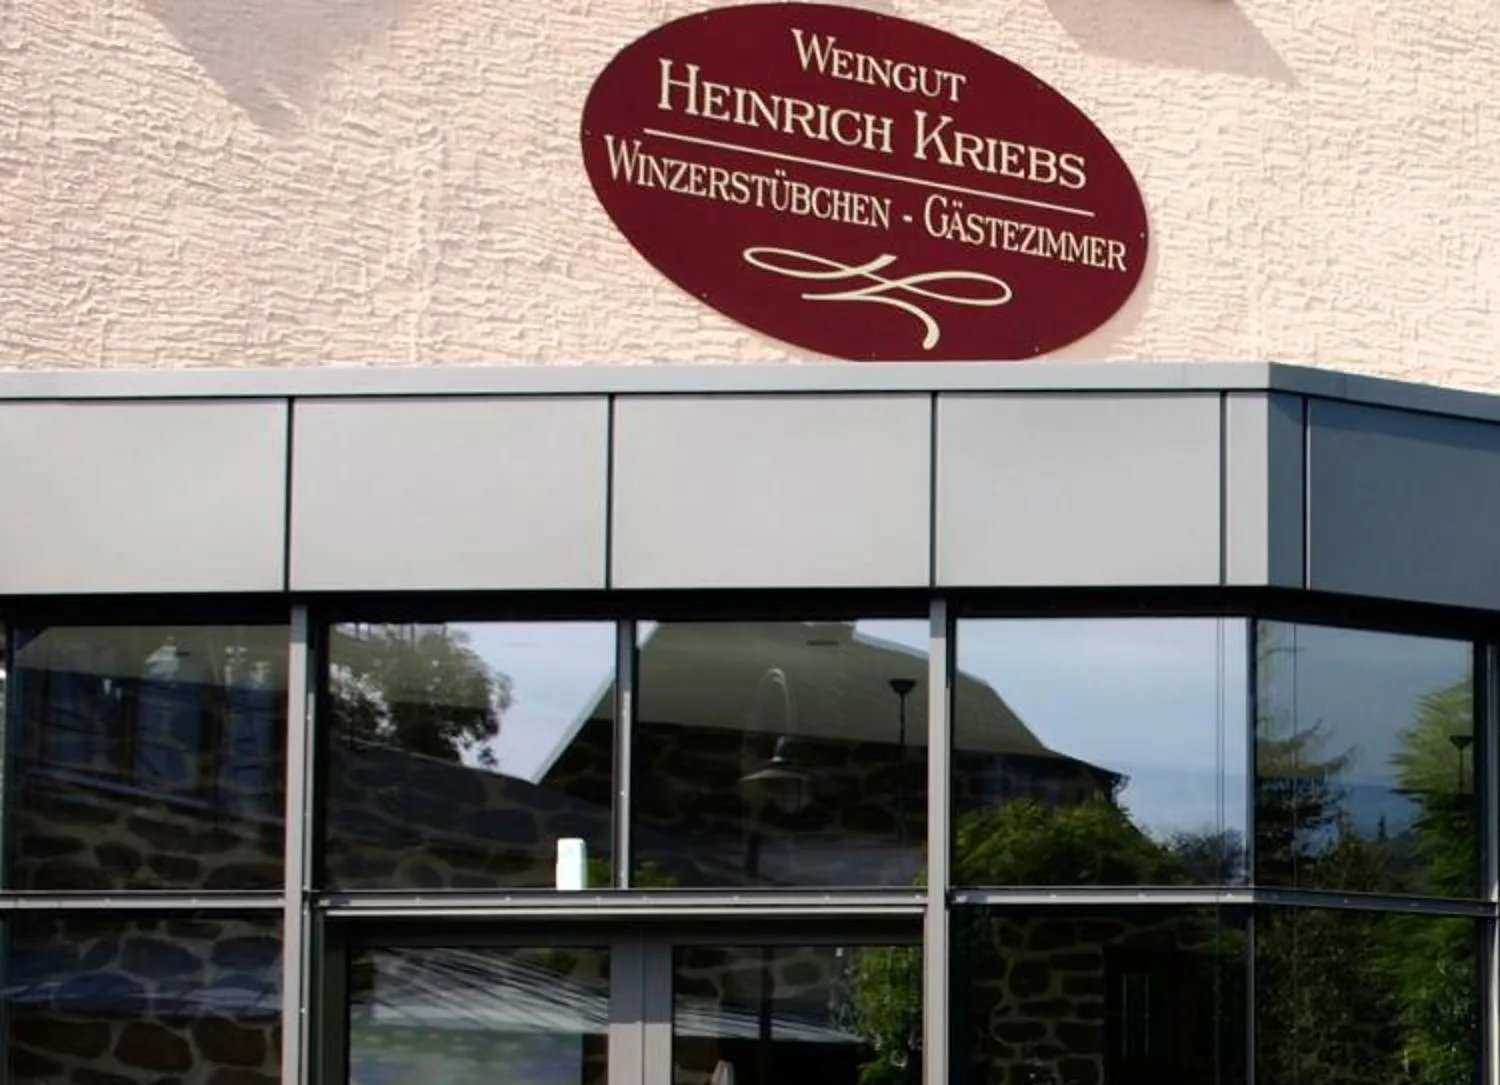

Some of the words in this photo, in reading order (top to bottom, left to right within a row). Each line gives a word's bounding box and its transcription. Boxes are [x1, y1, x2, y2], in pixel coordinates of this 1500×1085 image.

[791, 28, 967, 102] WEINGUT
[657, 57, 894, 154] HEINRICH
[913, 109, 1087, 190] KRIEBS
